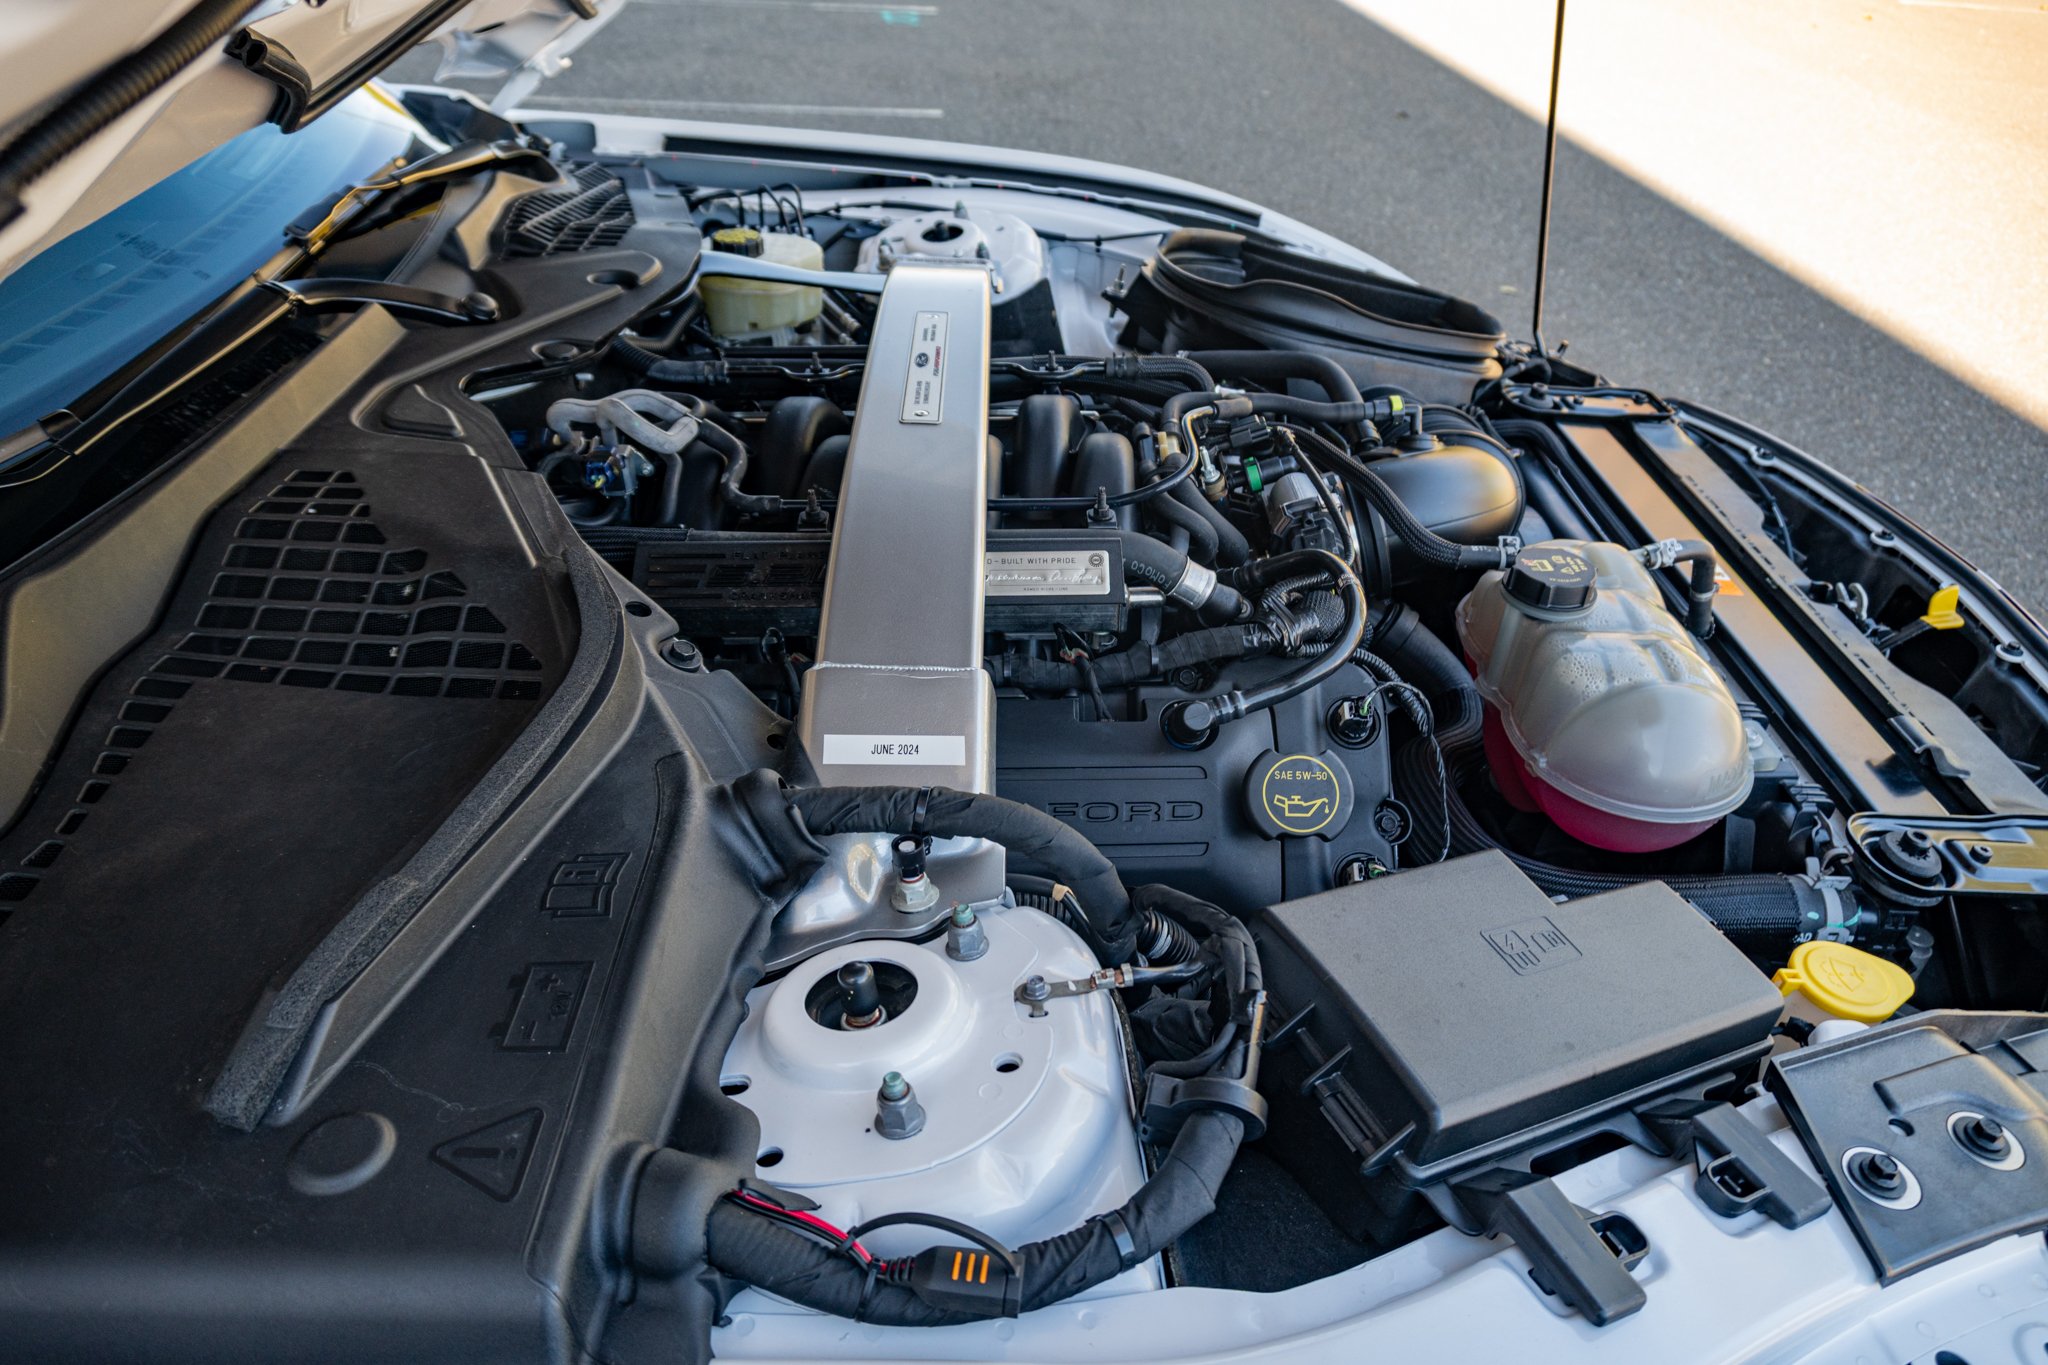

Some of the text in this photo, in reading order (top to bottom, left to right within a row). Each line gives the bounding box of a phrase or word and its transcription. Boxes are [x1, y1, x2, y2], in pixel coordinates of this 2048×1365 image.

[871, 744, 919, 755] JUNE 2024
[1274, 770, 1328, 780] SAE 5W-50
[1047, 801, 1204, 823] FORD
